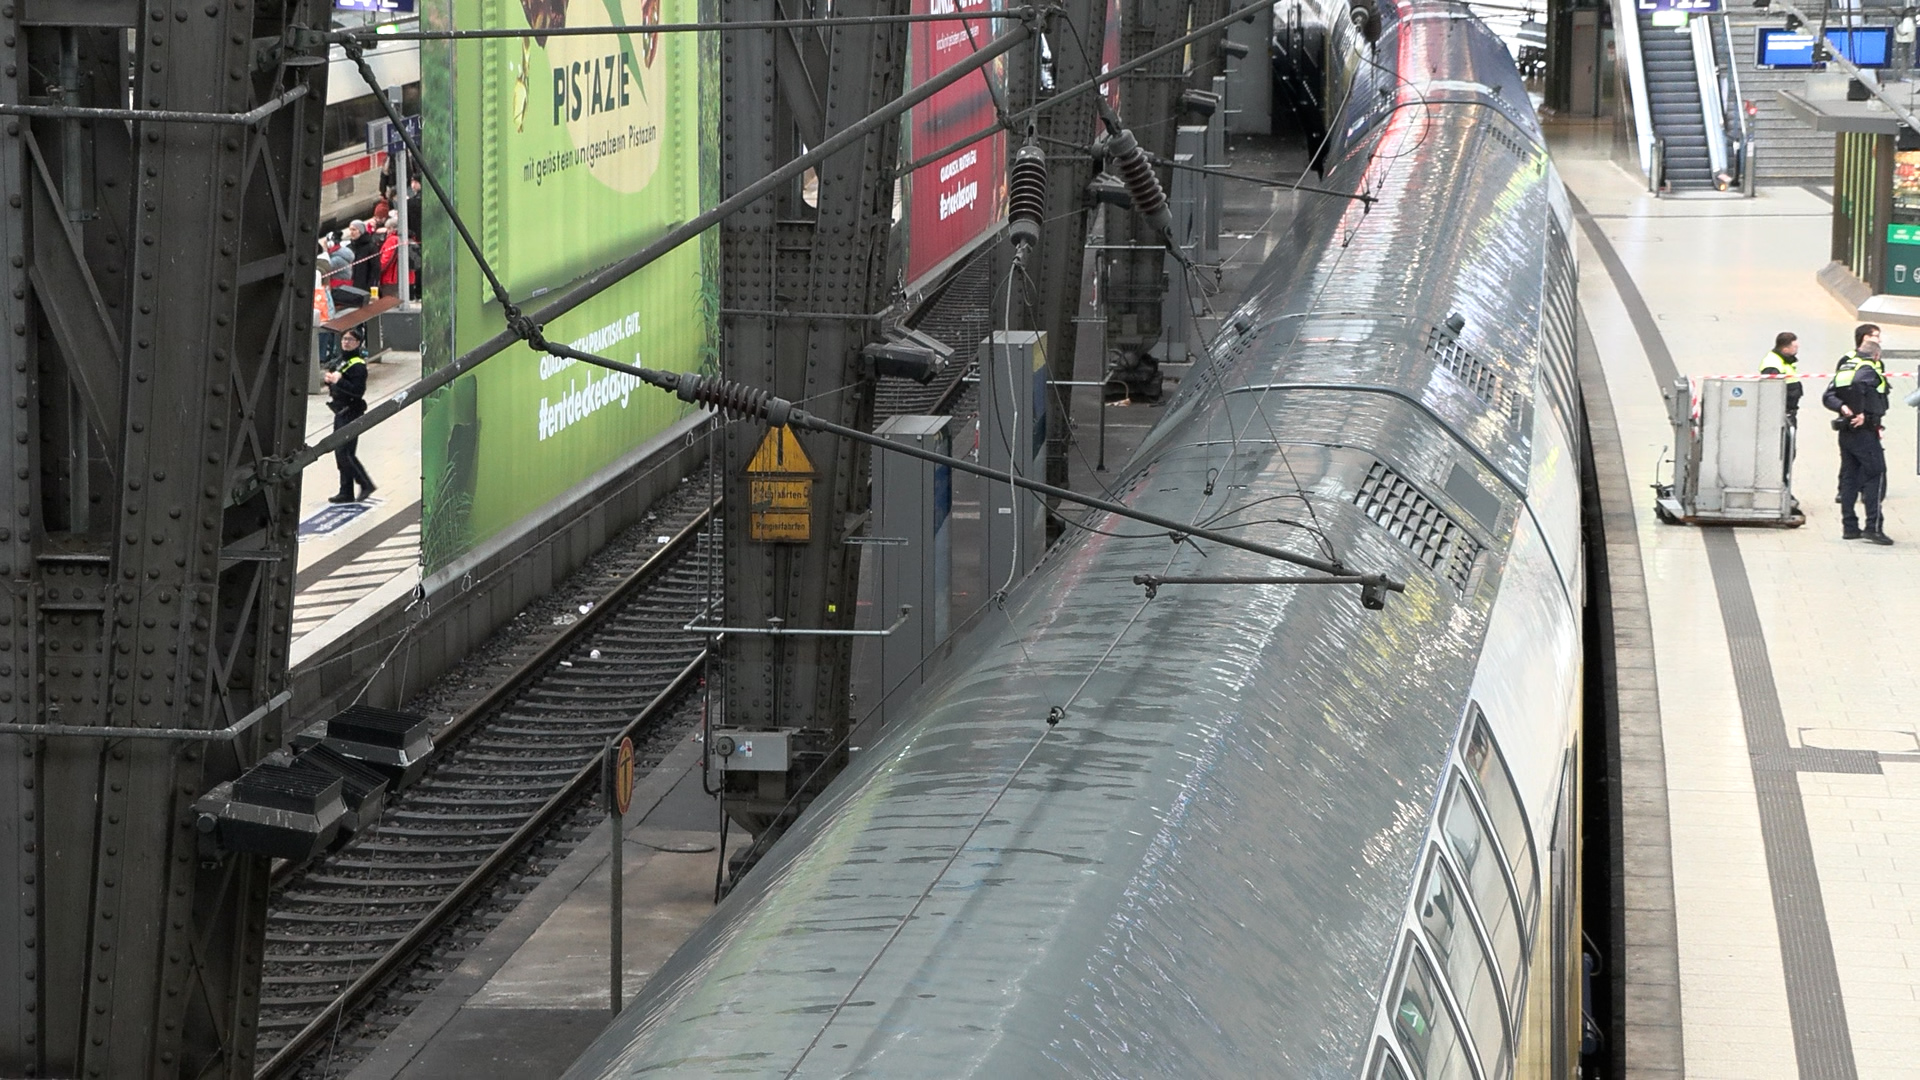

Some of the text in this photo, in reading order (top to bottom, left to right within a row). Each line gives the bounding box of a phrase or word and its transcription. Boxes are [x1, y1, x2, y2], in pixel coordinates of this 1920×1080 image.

[553, 52, 629, 126] PISTAZIE
[523, 157, 535, 182] mit
[625, 311, 641, 338] GUT.
[539, 353, 641, 441] #entdeckedasgut
[760, 487, 802, 500] ugfahrten
